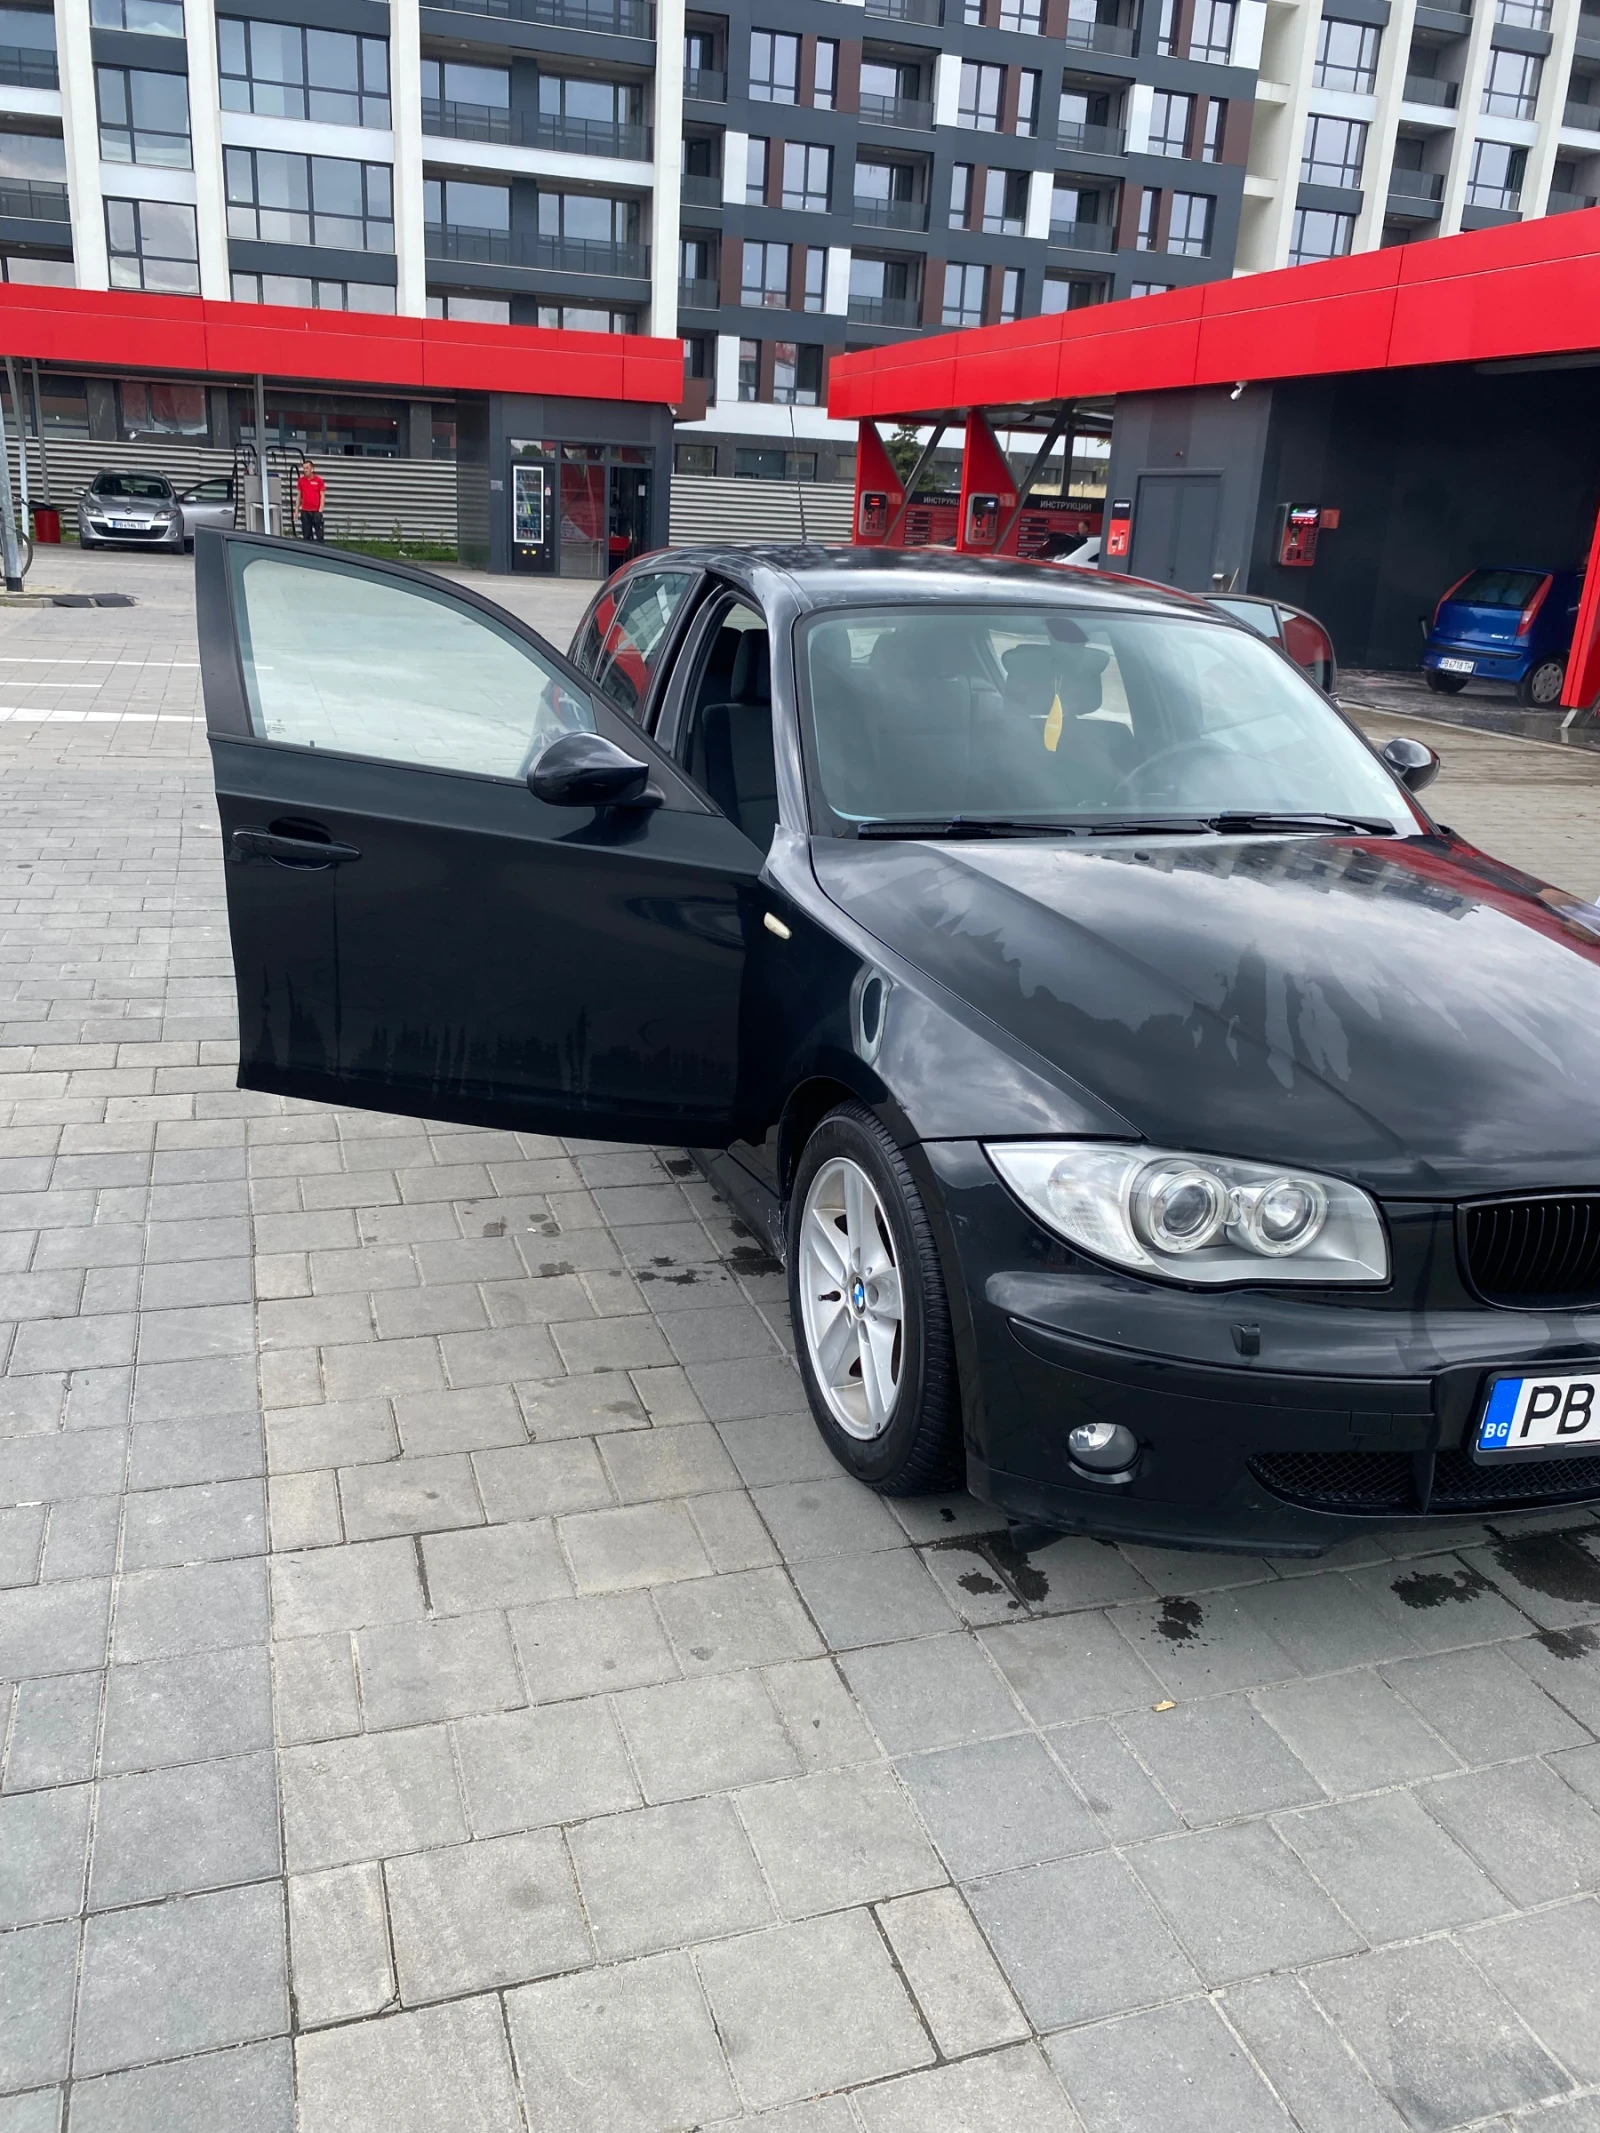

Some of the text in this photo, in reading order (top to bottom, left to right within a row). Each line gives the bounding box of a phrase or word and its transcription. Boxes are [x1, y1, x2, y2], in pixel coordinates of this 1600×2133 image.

[923, 496, 960, 507] ИНСТРУКЦ
[1040, 500, 1092, 512] ИНСТРУКЦИИ
[1520, 1383, 1595, 1438] PB
[1484, 1422, 1509, 1439] BG
